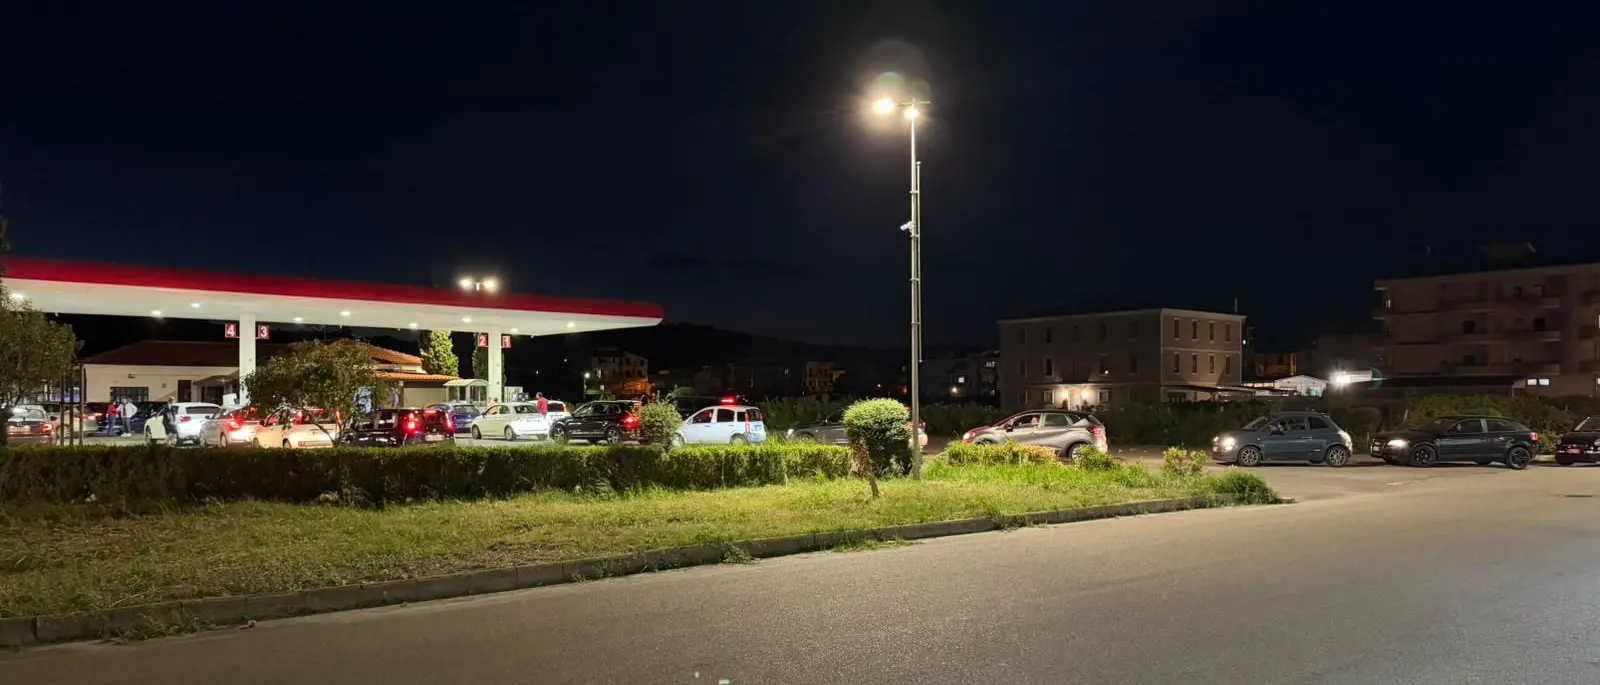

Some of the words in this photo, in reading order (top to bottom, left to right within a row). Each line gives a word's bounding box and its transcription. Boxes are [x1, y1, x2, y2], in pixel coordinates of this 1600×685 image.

[227, 324, 236, 337] 4
[260, 325, 268, 338] 3
[479, 335, 487, 346] 2
